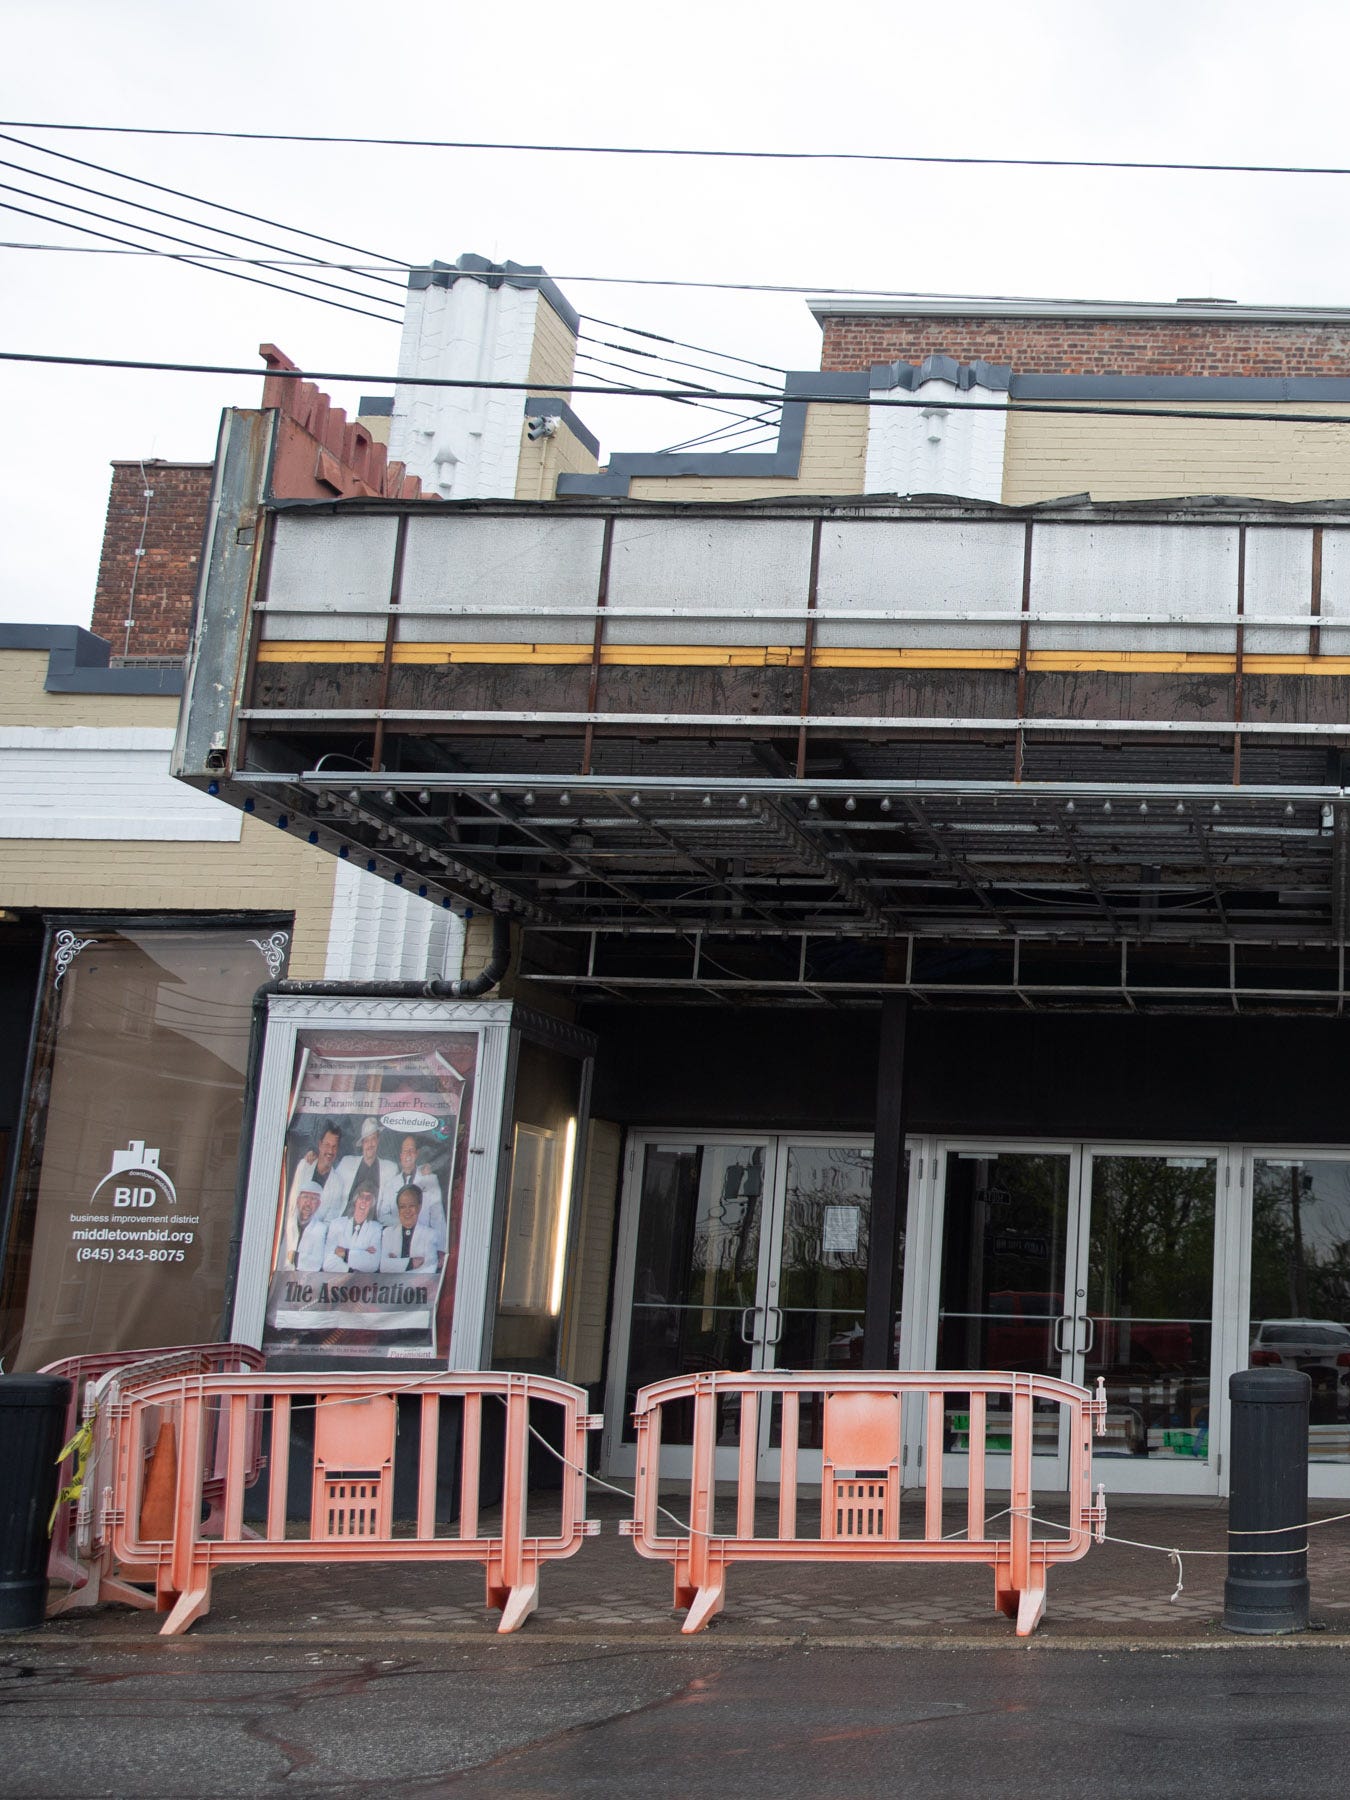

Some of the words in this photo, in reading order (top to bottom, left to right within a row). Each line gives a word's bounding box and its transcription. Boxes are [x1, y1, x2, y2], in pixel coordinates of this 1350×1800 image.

[302, 1096, 321, 1108] The
[323, 1097, 374, 1108] Paramount
[378, 1097, 410, 1108] Theatre
[413, 1097, 450, 1109] Presents
[383, 1116, 436, 1128] Rescheduled
[113, 1187, 157, 1208] BID
[70, 1213, 109, 1223] business
[111, 1213, 168, 1225] improvement
[170, 1214, 200, 1224] district
[72, 1228, 194, 1244] middletownbid.org
[76, 1247, 114, 1263] (845)
[117, 1248, 185, 1262] 343-8075
[285, 1281, 313, 1303] The
[318, 1282, 428, 1305] Association
